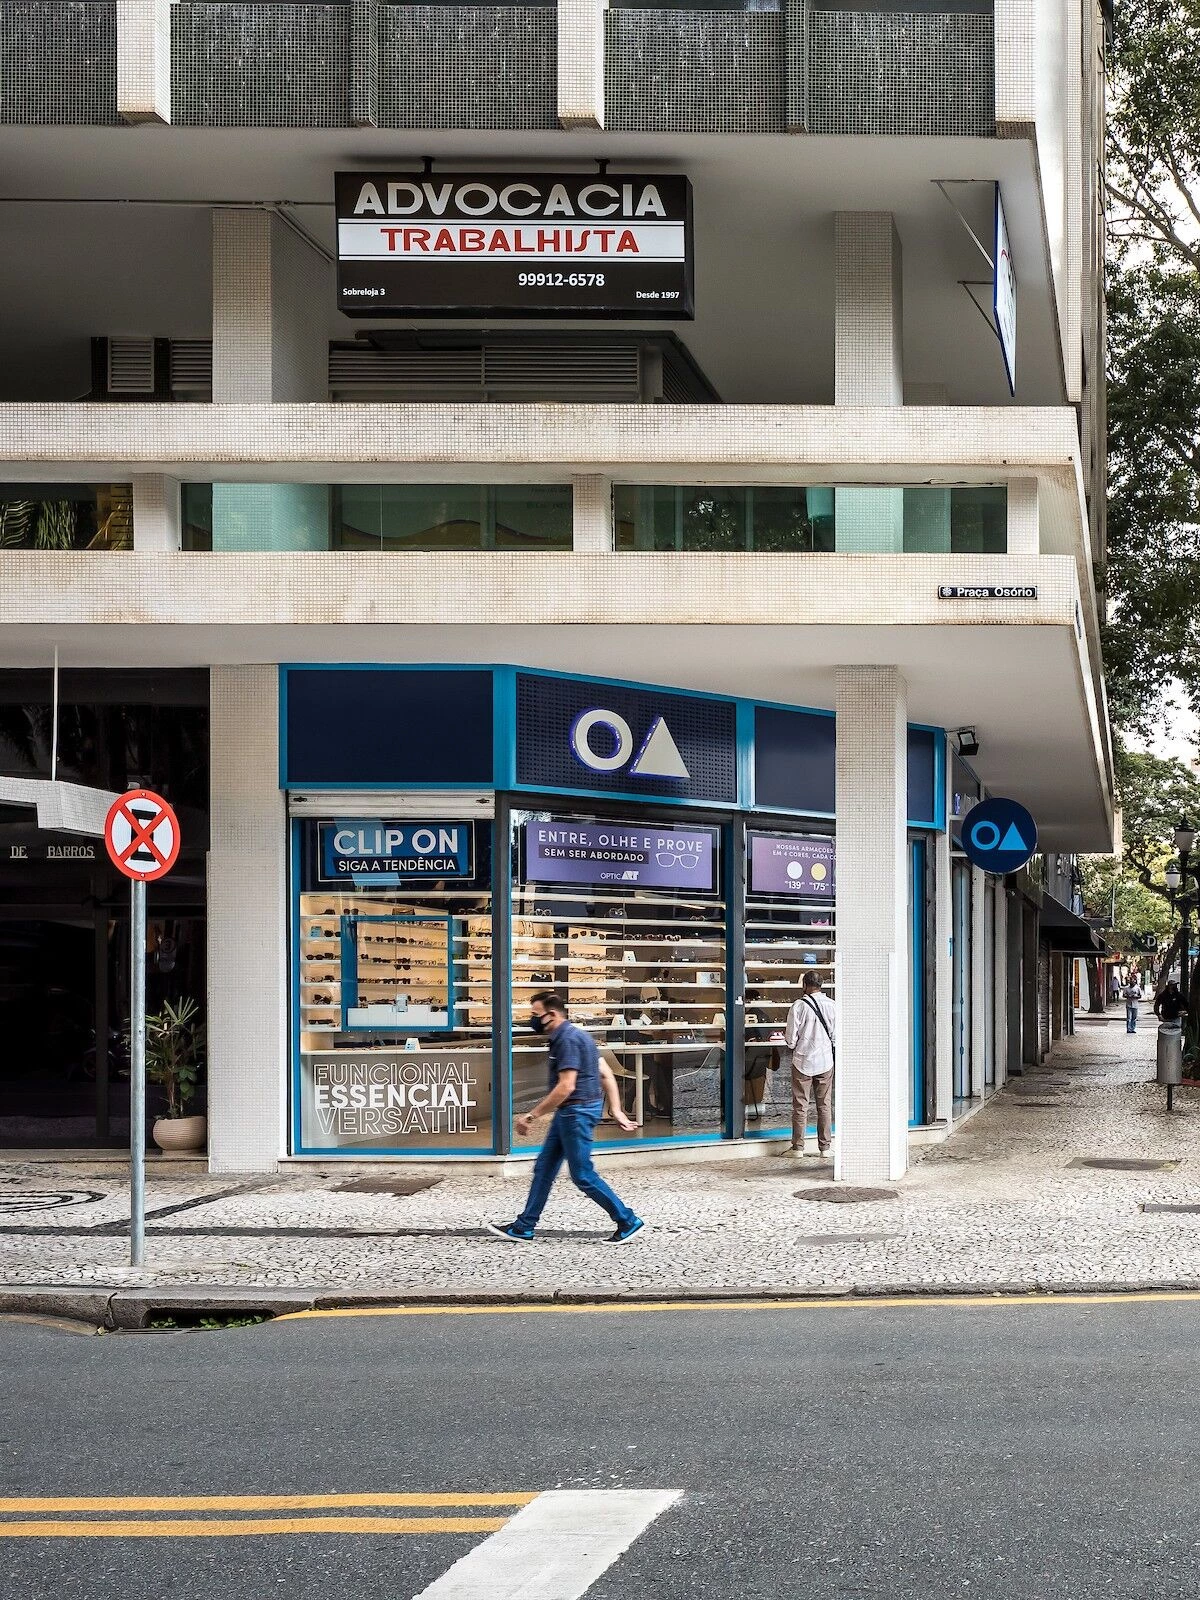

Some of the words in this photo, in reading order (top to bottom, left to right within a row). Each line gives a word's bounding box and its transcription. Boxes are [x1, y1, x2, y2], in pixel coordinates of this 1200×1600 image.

[353, 182, 667, 217] ADVOCACIA
[380, 228, 640, 253] TRABALHISTA
[518, 272, 605, 287] 99912-6578
[343, 287, 378, 297] Sobreloja
[380, 287, 386, 296] 3
[636, 291, 659, 299] Desde
[660, 291, 680, 299] 1997
[957, 587, 989, 598] Praça
[994, 587, 1033, 597] Osório
[333, 829, 404, 855] CLIP
[411, 828, 458, 854] ON
[538, 830, 592, 847] ENTRE,
[598, 834, 638, 848] OLHE
[643, 837, 651, 849] E
[657, 838, 703, 852] PROVE
[10, 846, 28, 858] DE
[47, 846, 95, 858] BARROS
[544, 848, 566, 858] SEM
[568, 849, 587, 859] SER
[589, 851, 644, 862] ABORDADO
[338, 860, 369, 872] SIGA
[371, 860, 381, 871] A
[383, 857, 456, 871] TENDÊNCIA
[313, 1063, 477, 1086] FUNCIONAL
[314, 1083, 477, 1108] ESSENCIAL
